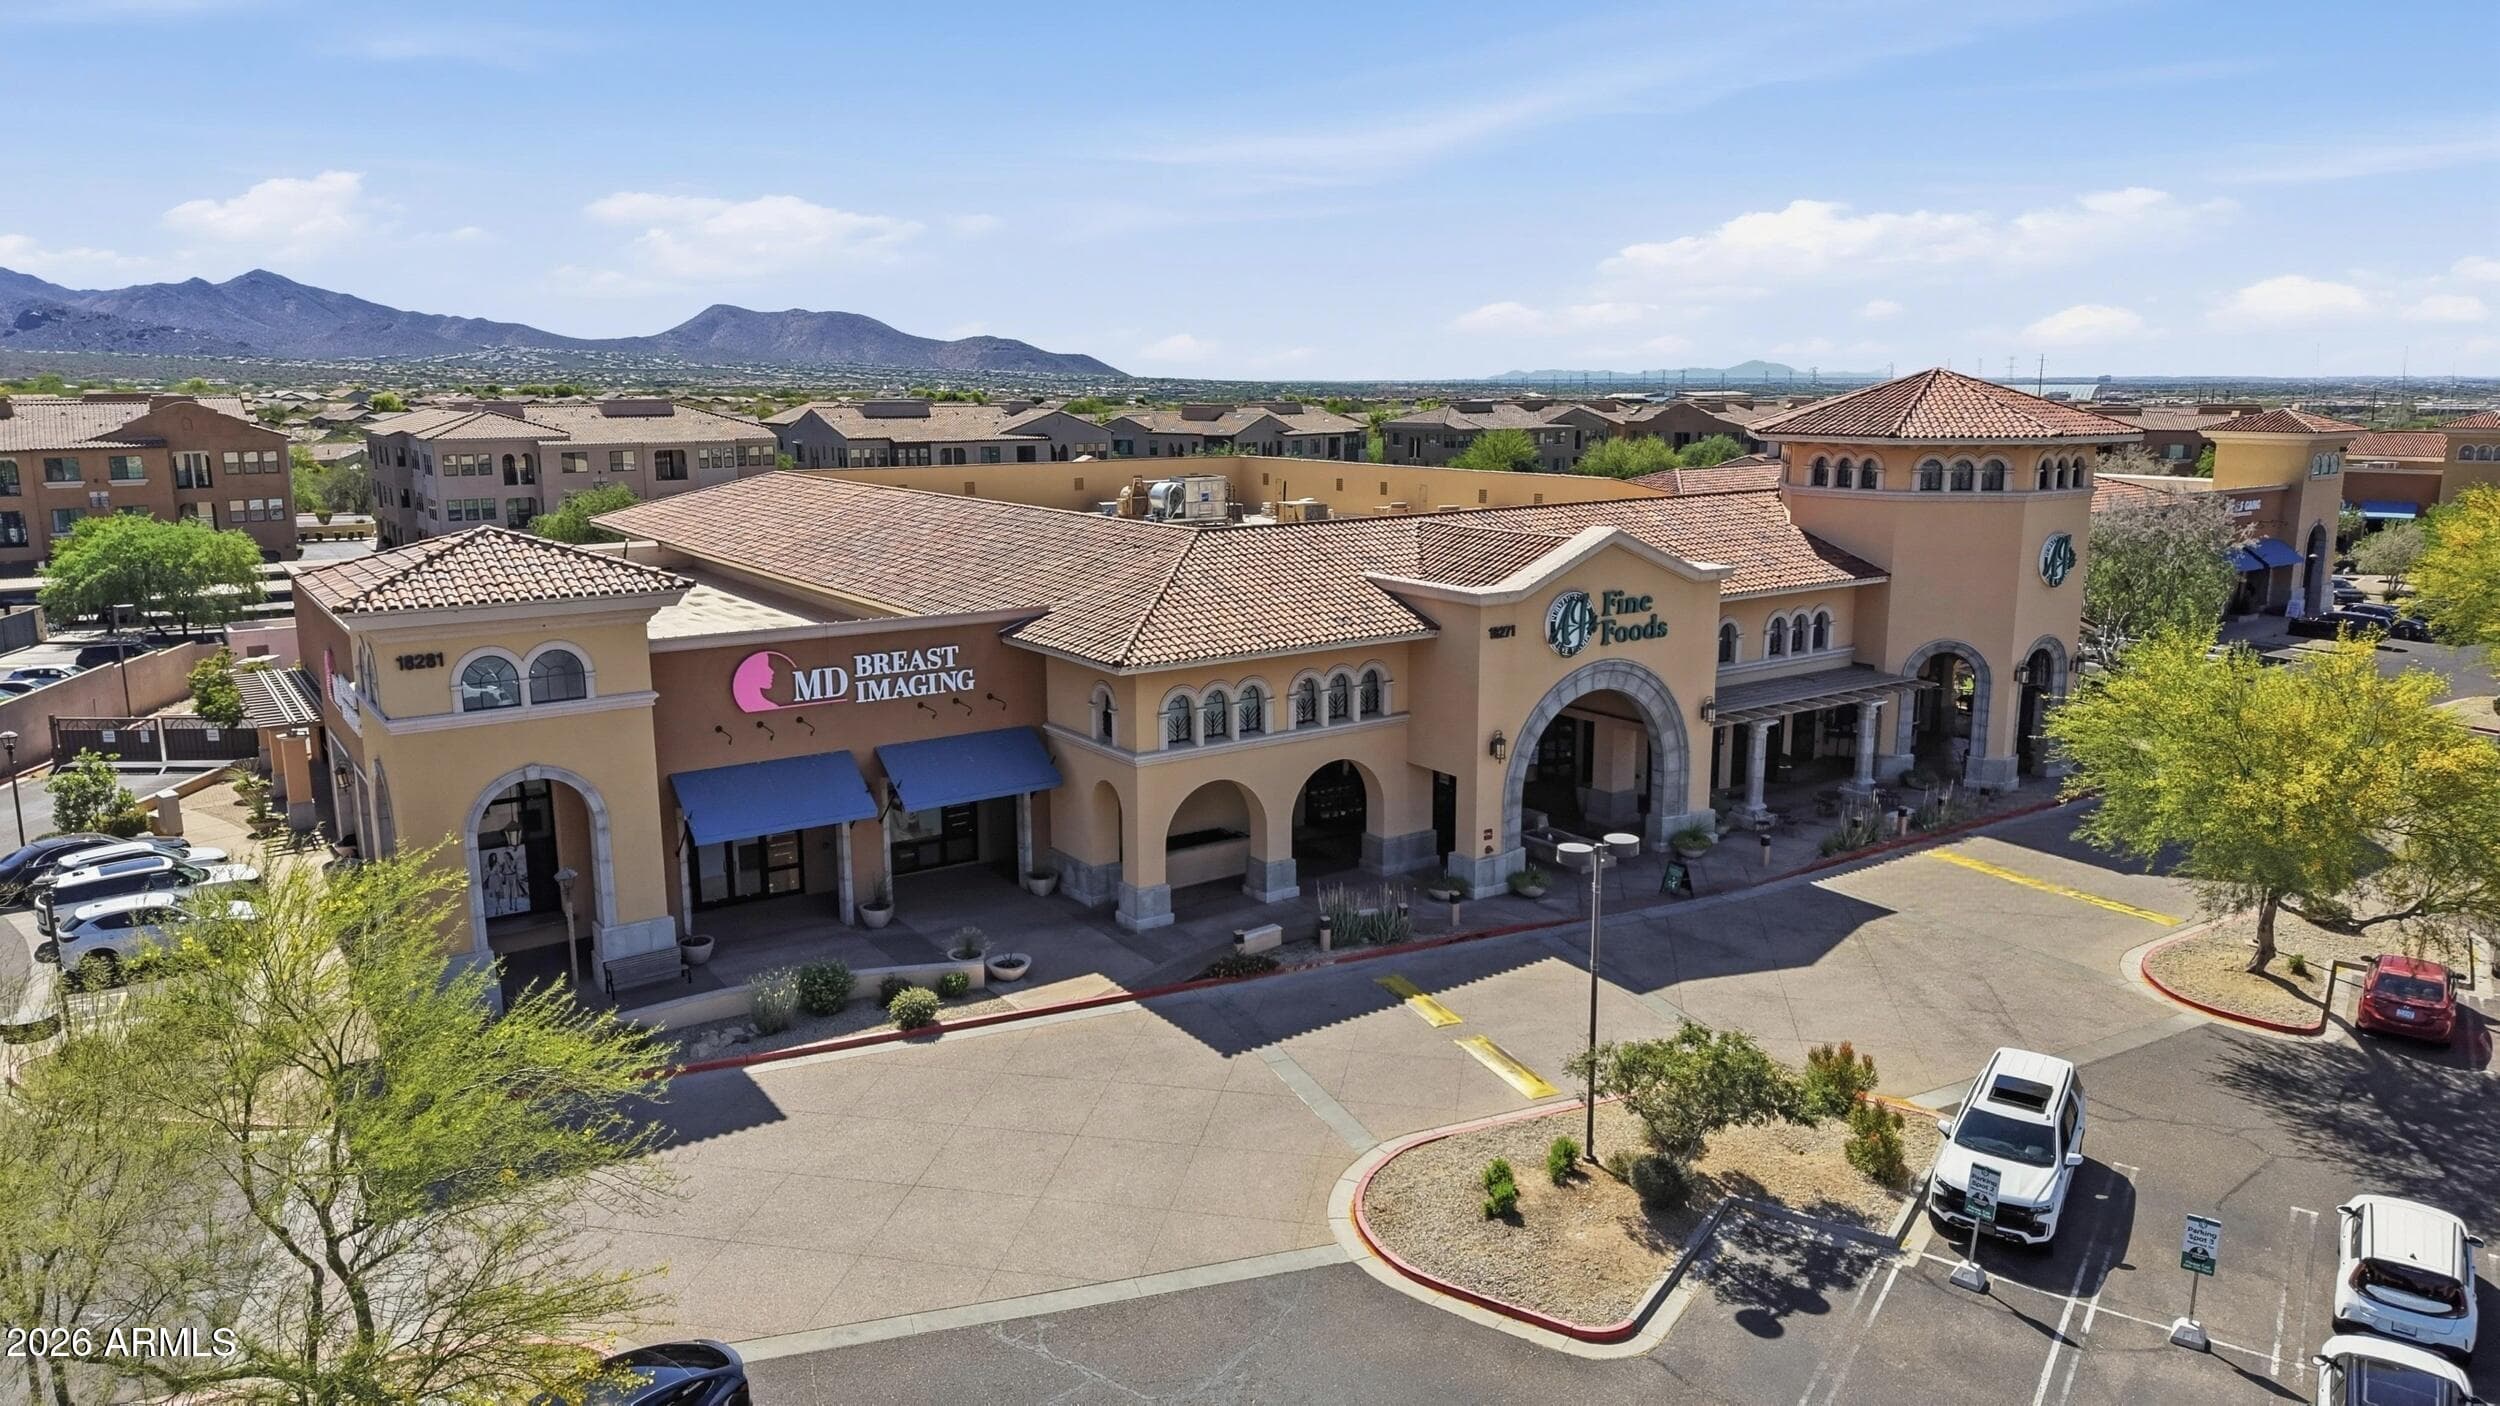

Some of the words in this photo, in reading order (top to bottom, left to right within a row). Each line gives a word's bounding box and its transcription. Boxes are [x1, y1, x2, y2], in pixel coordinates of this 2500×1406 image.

[1601, 590, 1654, 617] Fine
[1600, 613, 1668, 646] Foods
[395, 651, 444, 671] 18281
[853, 645, 959, 678] BREAST
[793, 666, 849, 702] MD
[855, 668, 975, 703] IMAGING
[2187, 1226, 2217, 1240] Parking
[2188, 1233, 2207, 1243] Spot
